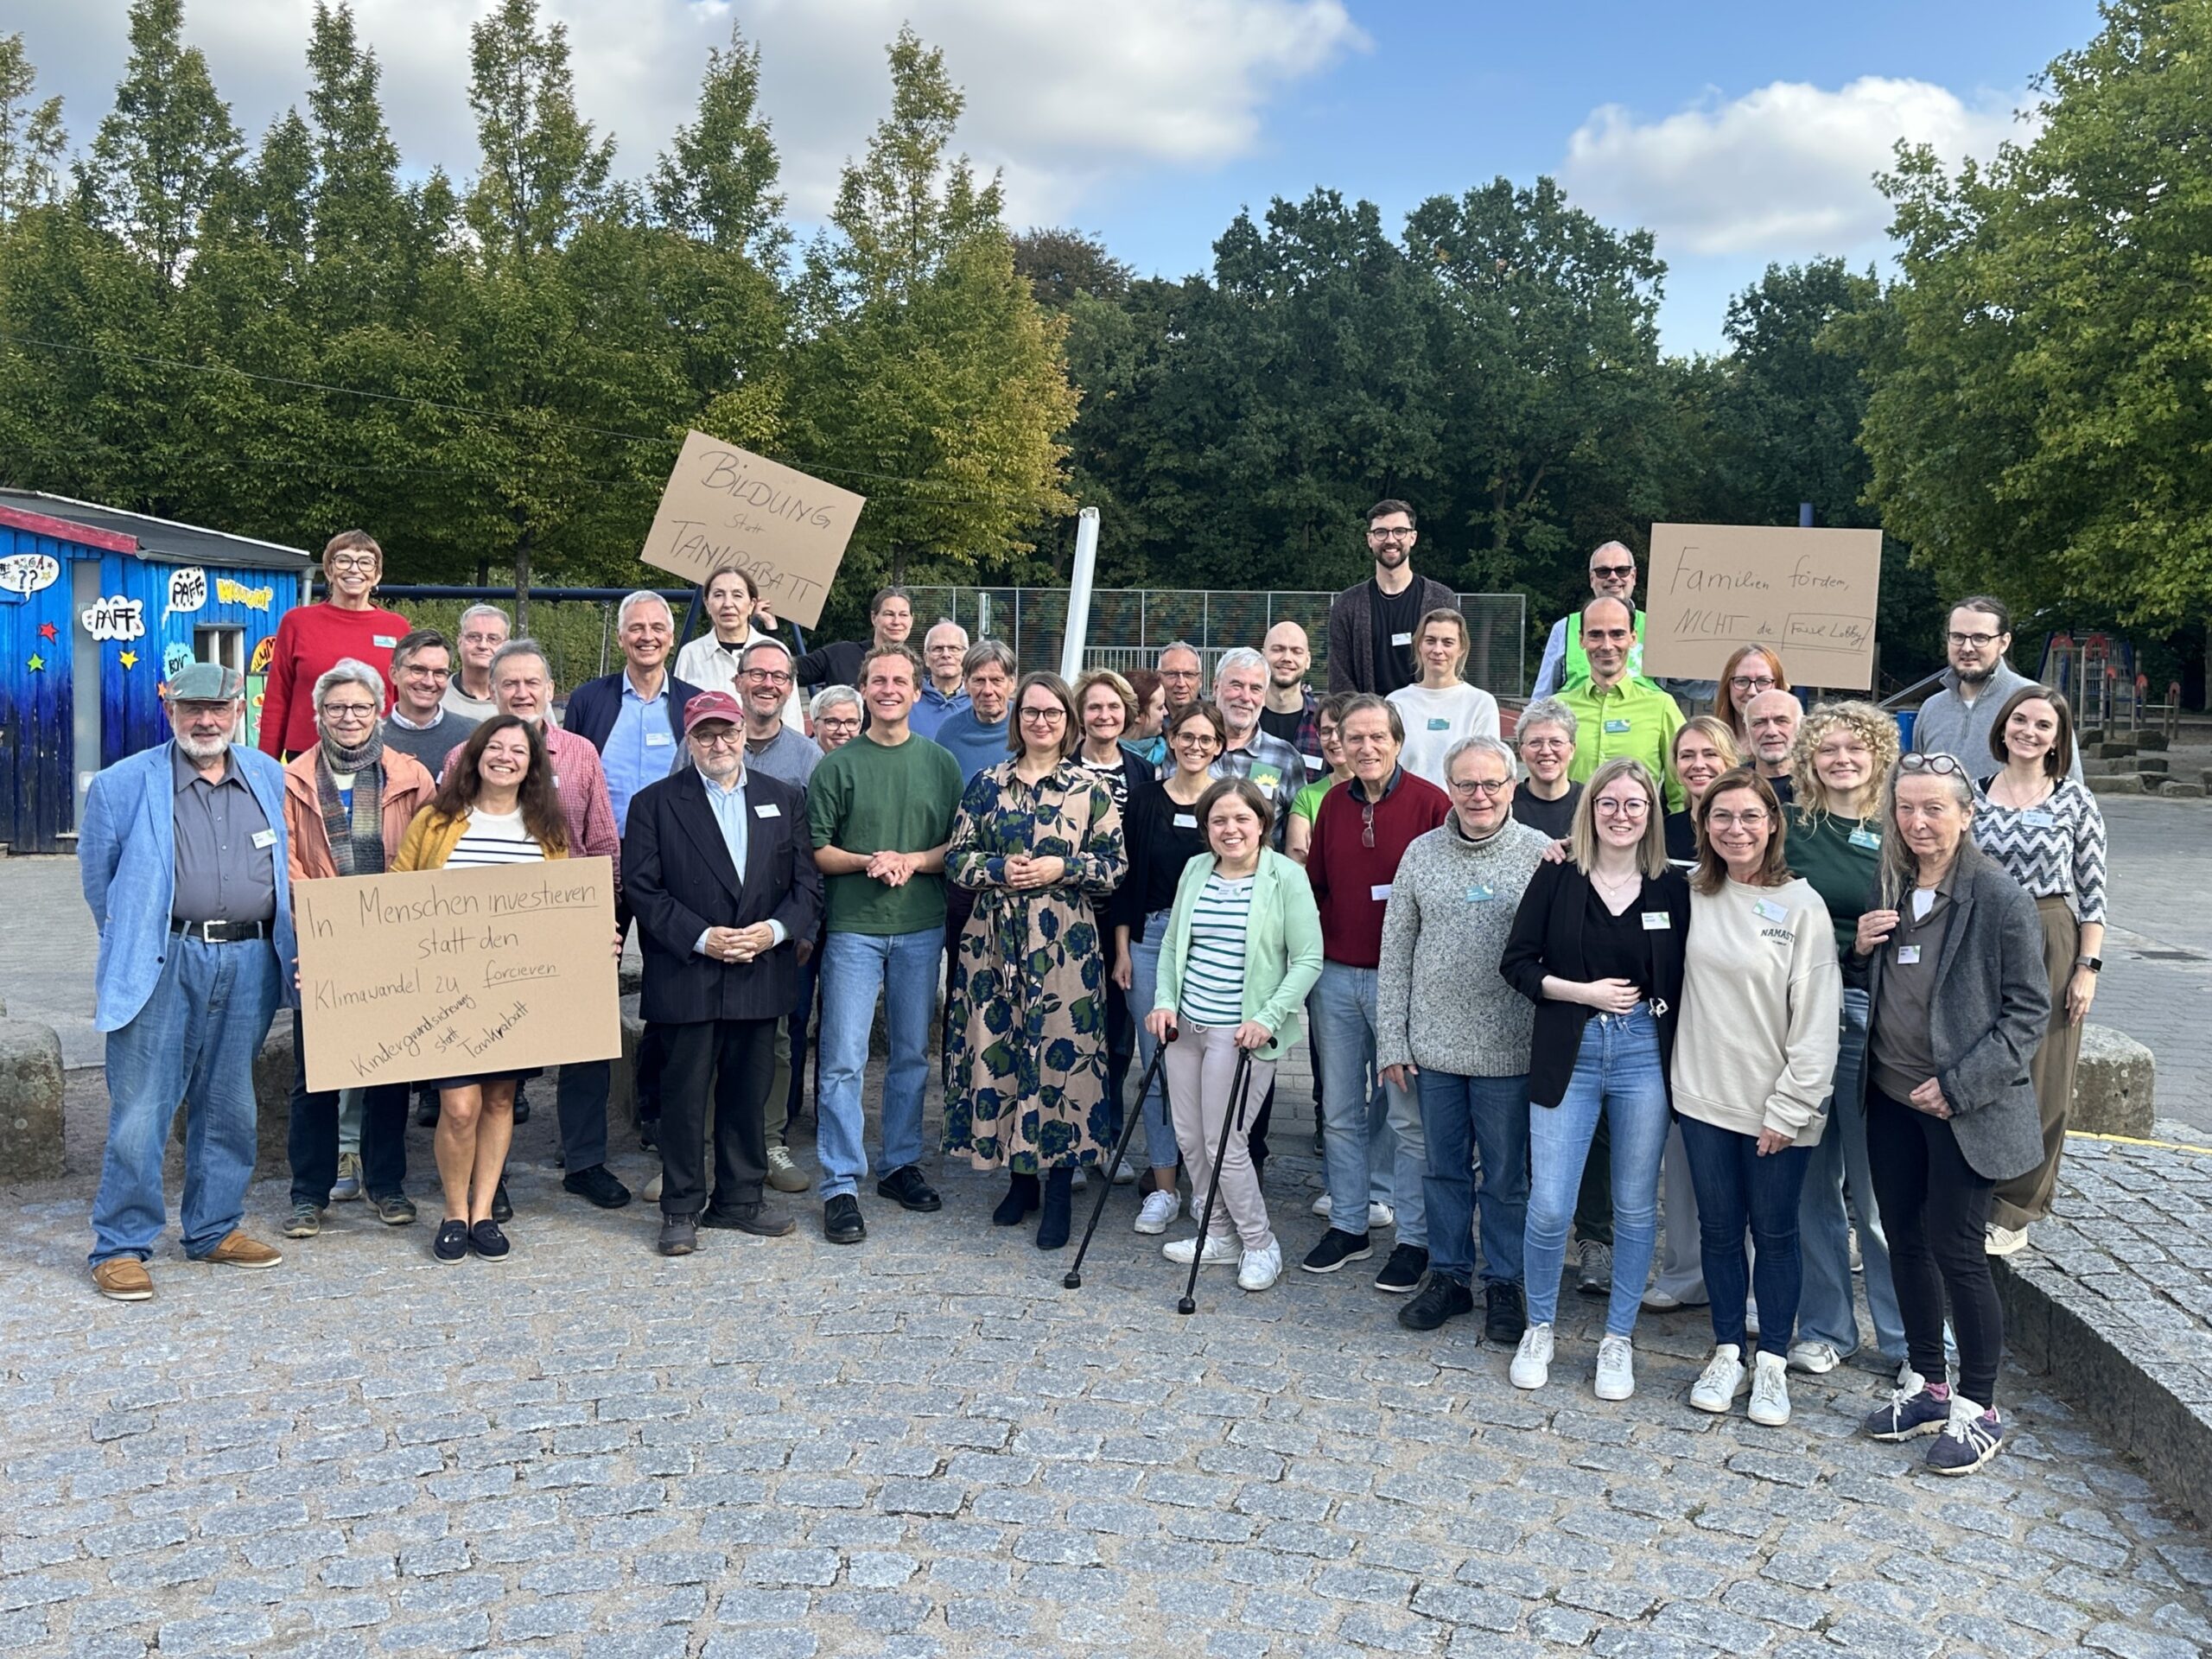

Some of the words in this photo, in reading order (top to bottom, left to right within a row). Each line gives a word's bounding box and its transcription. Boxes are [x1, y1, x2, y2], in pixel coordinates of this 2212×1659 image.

[172, 575, 202, 604] PAFF
[1669, 546, 1769, 595] Familien
[95, 607, 136, 632] PAFF
[1674, 607, 1750, 635] NICHT
[1756, 620, 1774, 635] die
[1829, 622, 1866, 645] Lobby
[307, 897, 334, 939] In
[359, 884, 480, 927] Menschen
[489, 880, 597, 913] investieren
[480, 925, 518, 950] den
[315, 968, 420, 1011] Klimawandel
[484, 959, 557, 989] forcieren
